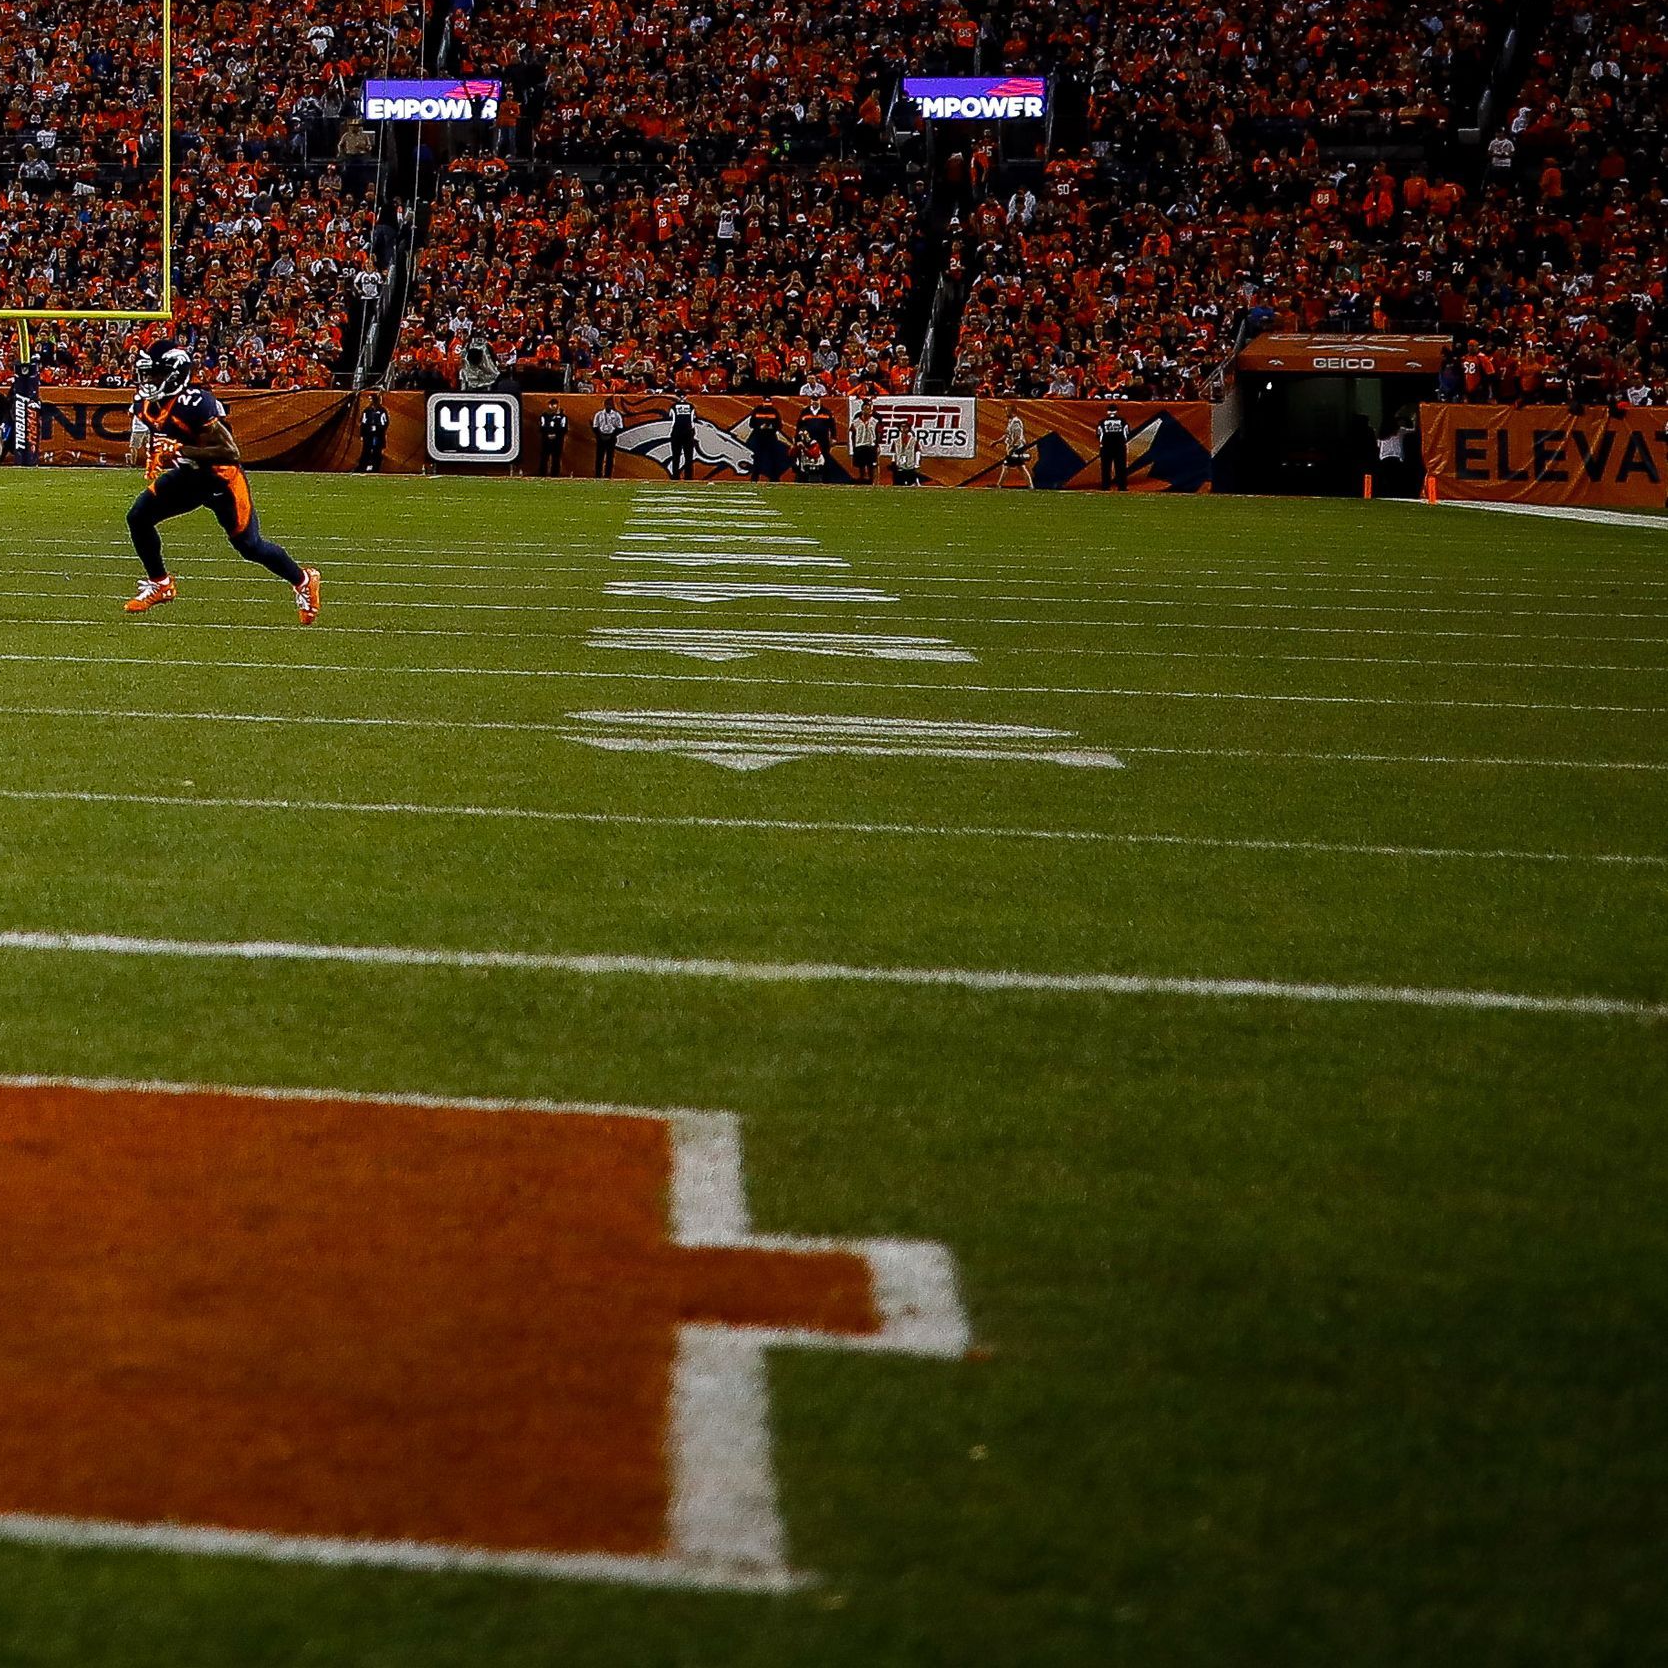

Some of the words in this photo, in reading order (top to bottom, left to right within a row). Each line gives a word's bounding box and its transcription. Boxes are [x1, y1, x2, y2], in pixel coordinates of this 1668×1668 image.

[367, 96, 497, 120] EMPOWR
[917, 95, 1043, 118] MPOWER
[1313, 357, 1375, 371] GEICO
[16, 394, 29, 450] FOOTBALL
[440, 407, 505, 450] 40
